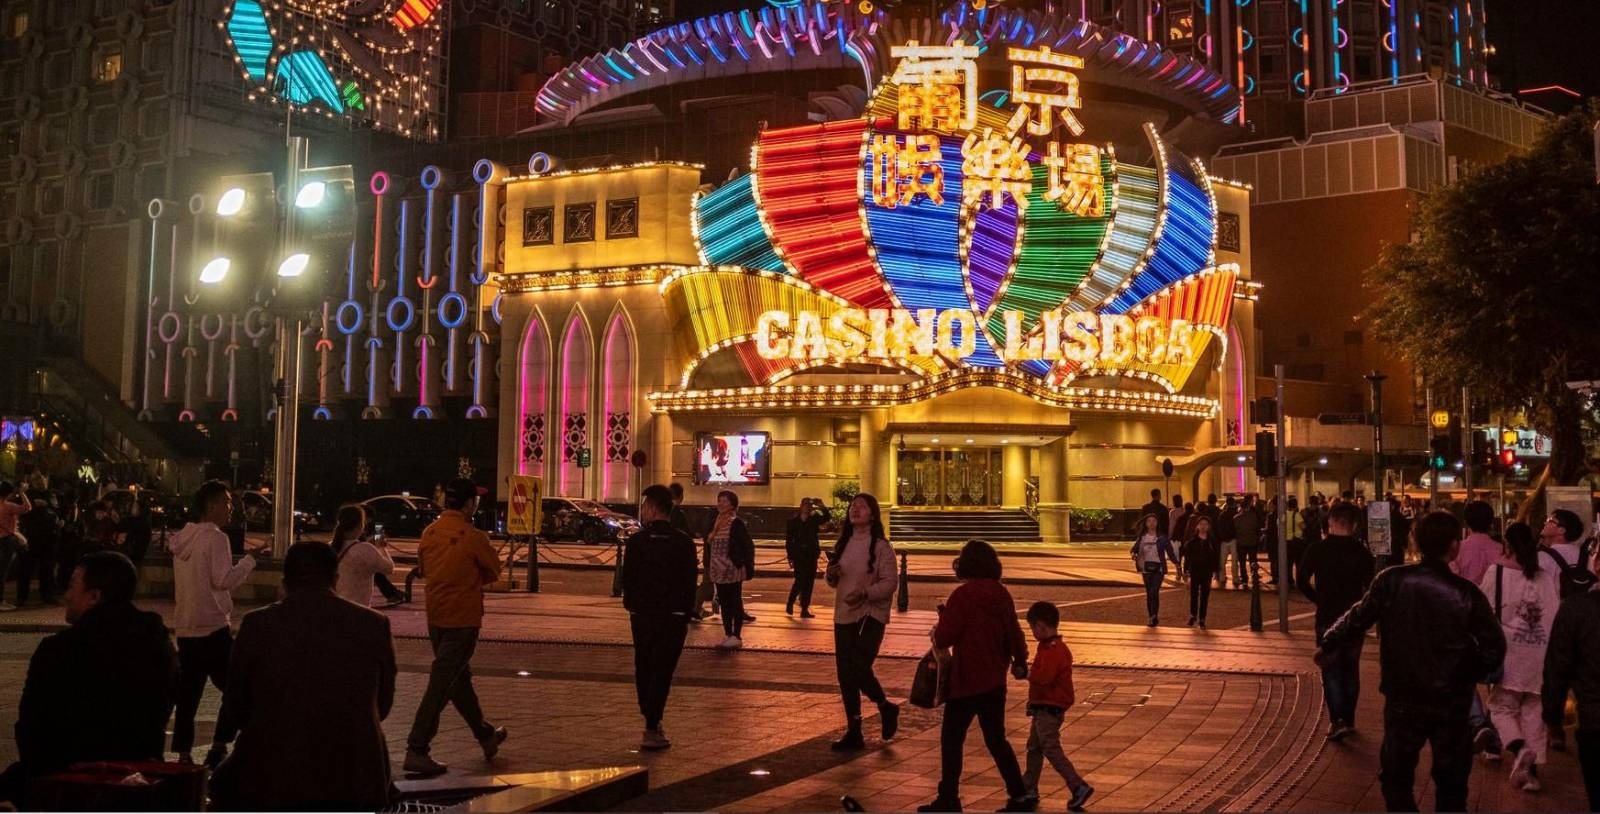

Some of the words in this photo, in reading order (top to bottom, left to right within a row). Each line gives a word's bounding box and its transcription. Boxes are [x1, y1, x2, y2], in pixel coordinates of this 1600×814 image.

[890, 40, 1085, 137] 葡京
[756, 308, 976, 361] CASINO
[1003, 310, 1194, 364] LISBOA
